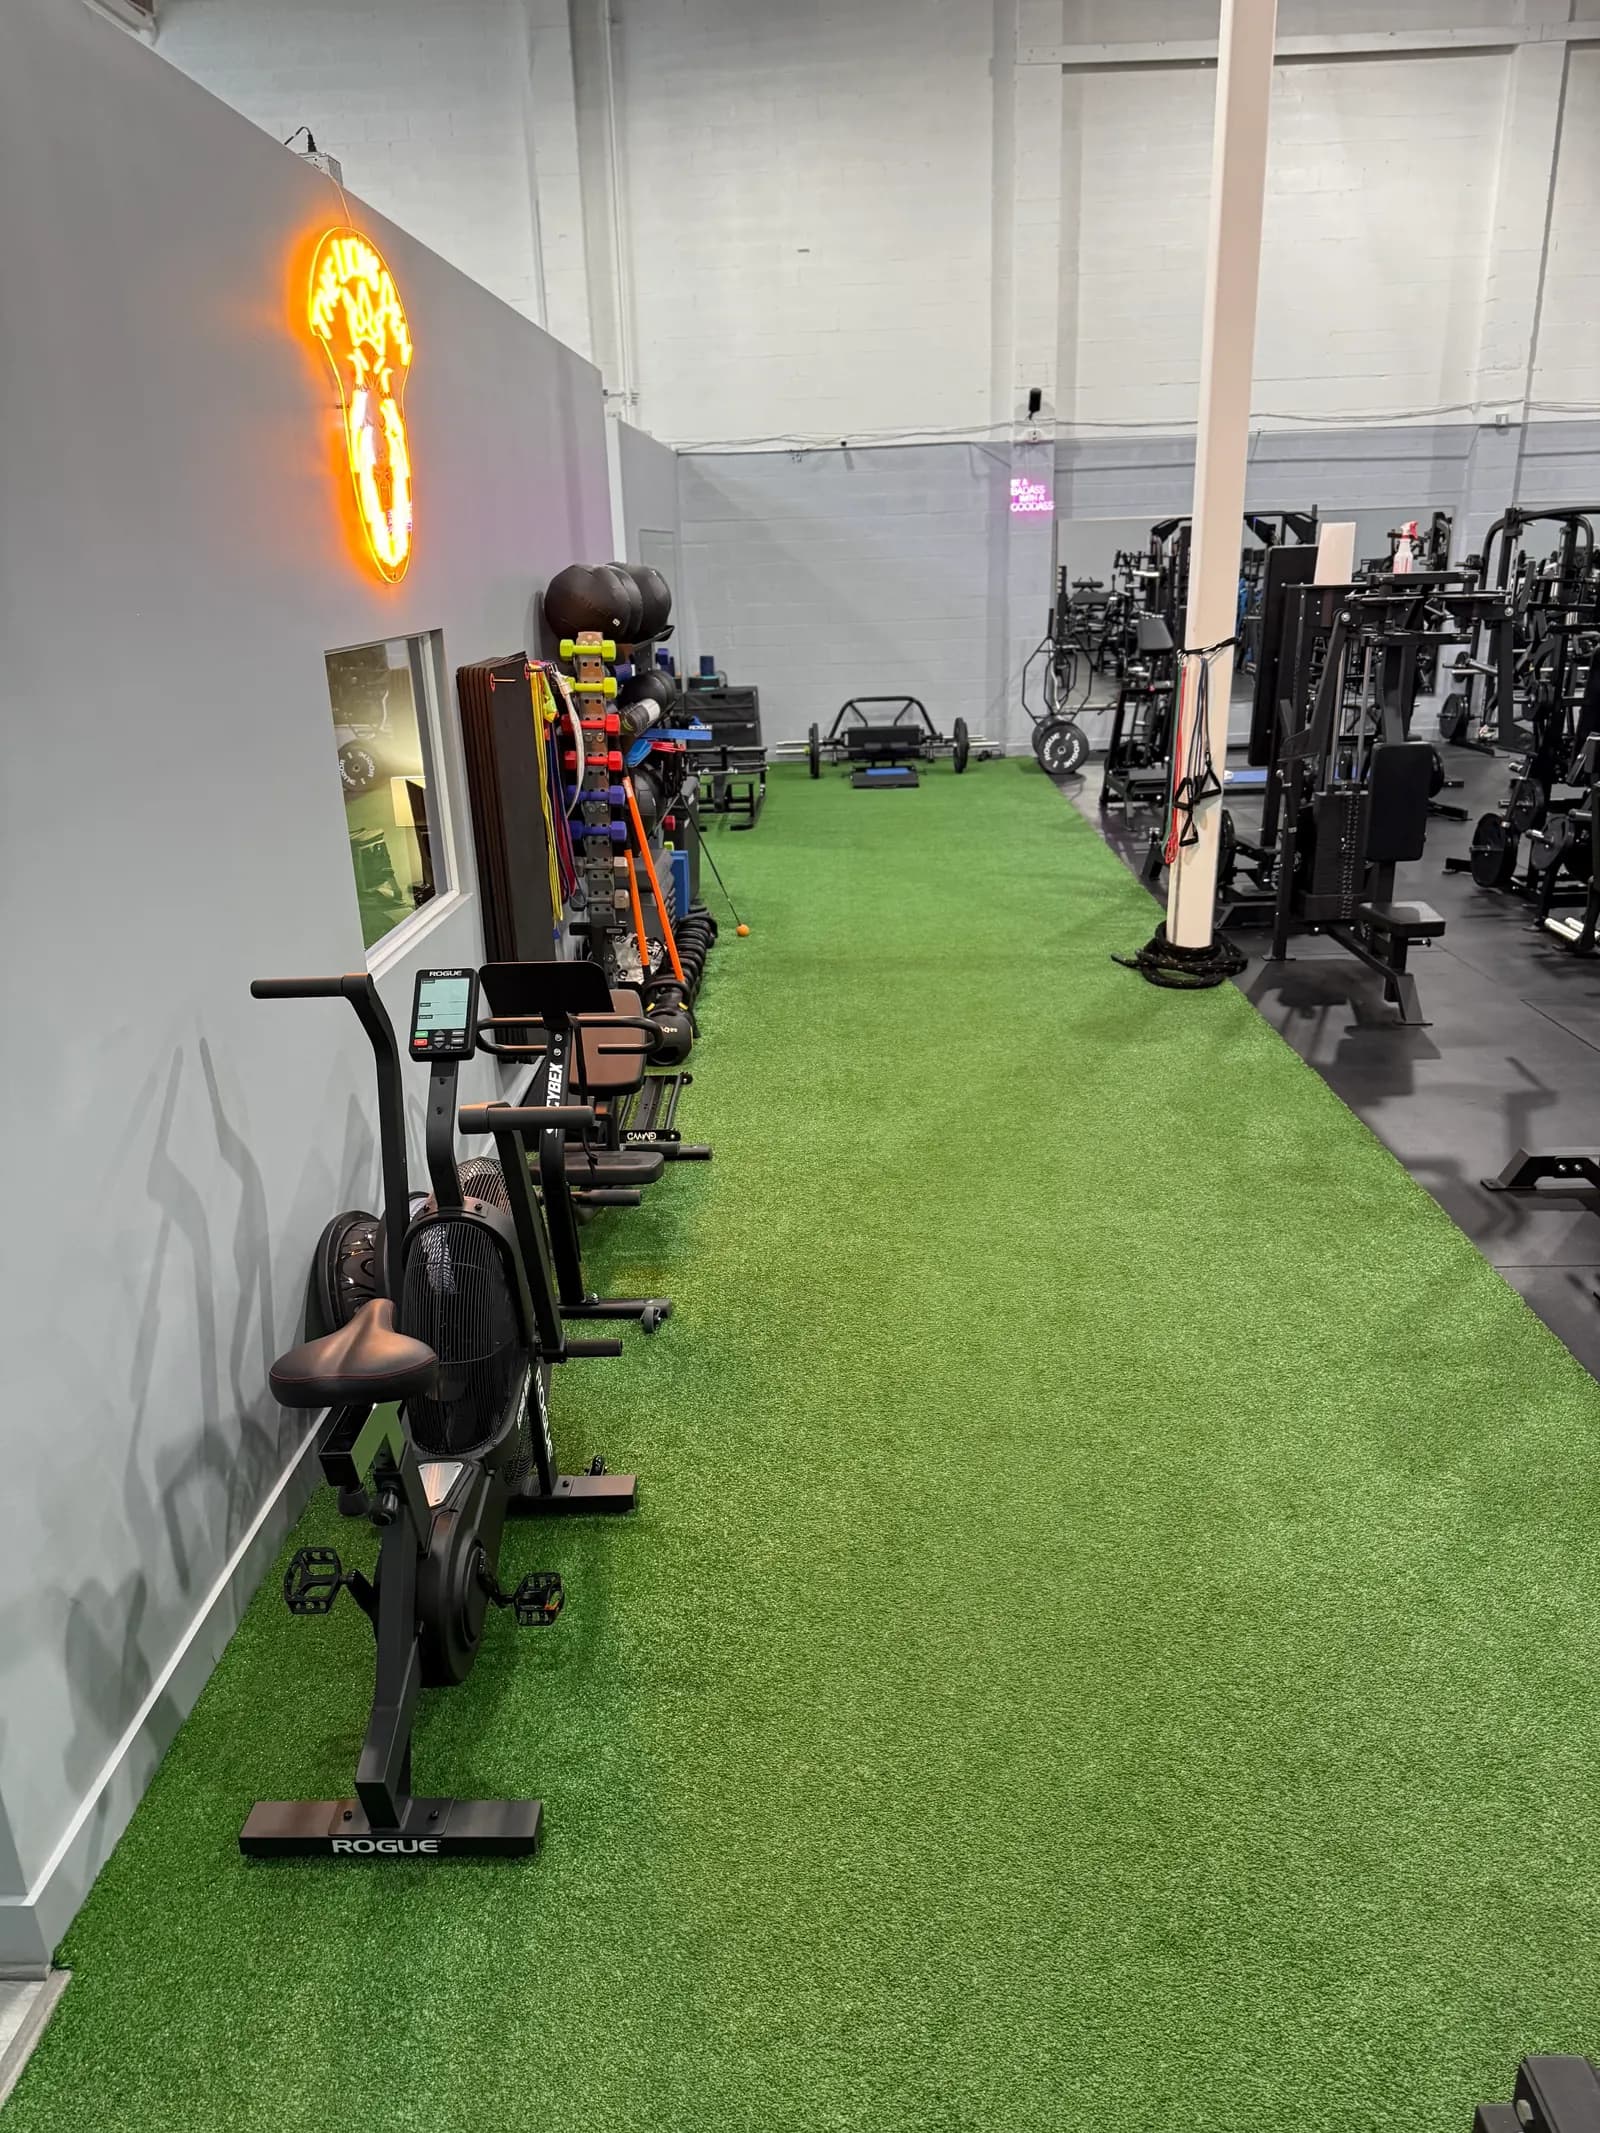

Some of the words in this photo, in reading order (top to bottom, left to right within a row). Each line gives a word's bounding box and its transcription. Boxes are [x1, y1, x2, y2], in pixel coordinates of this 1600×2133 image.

[1010, 485, 1045, 496] BADASS
[536, 1365, 554, 1463] ROGUE
[332, 1839, 439, 1853] ROGUE
